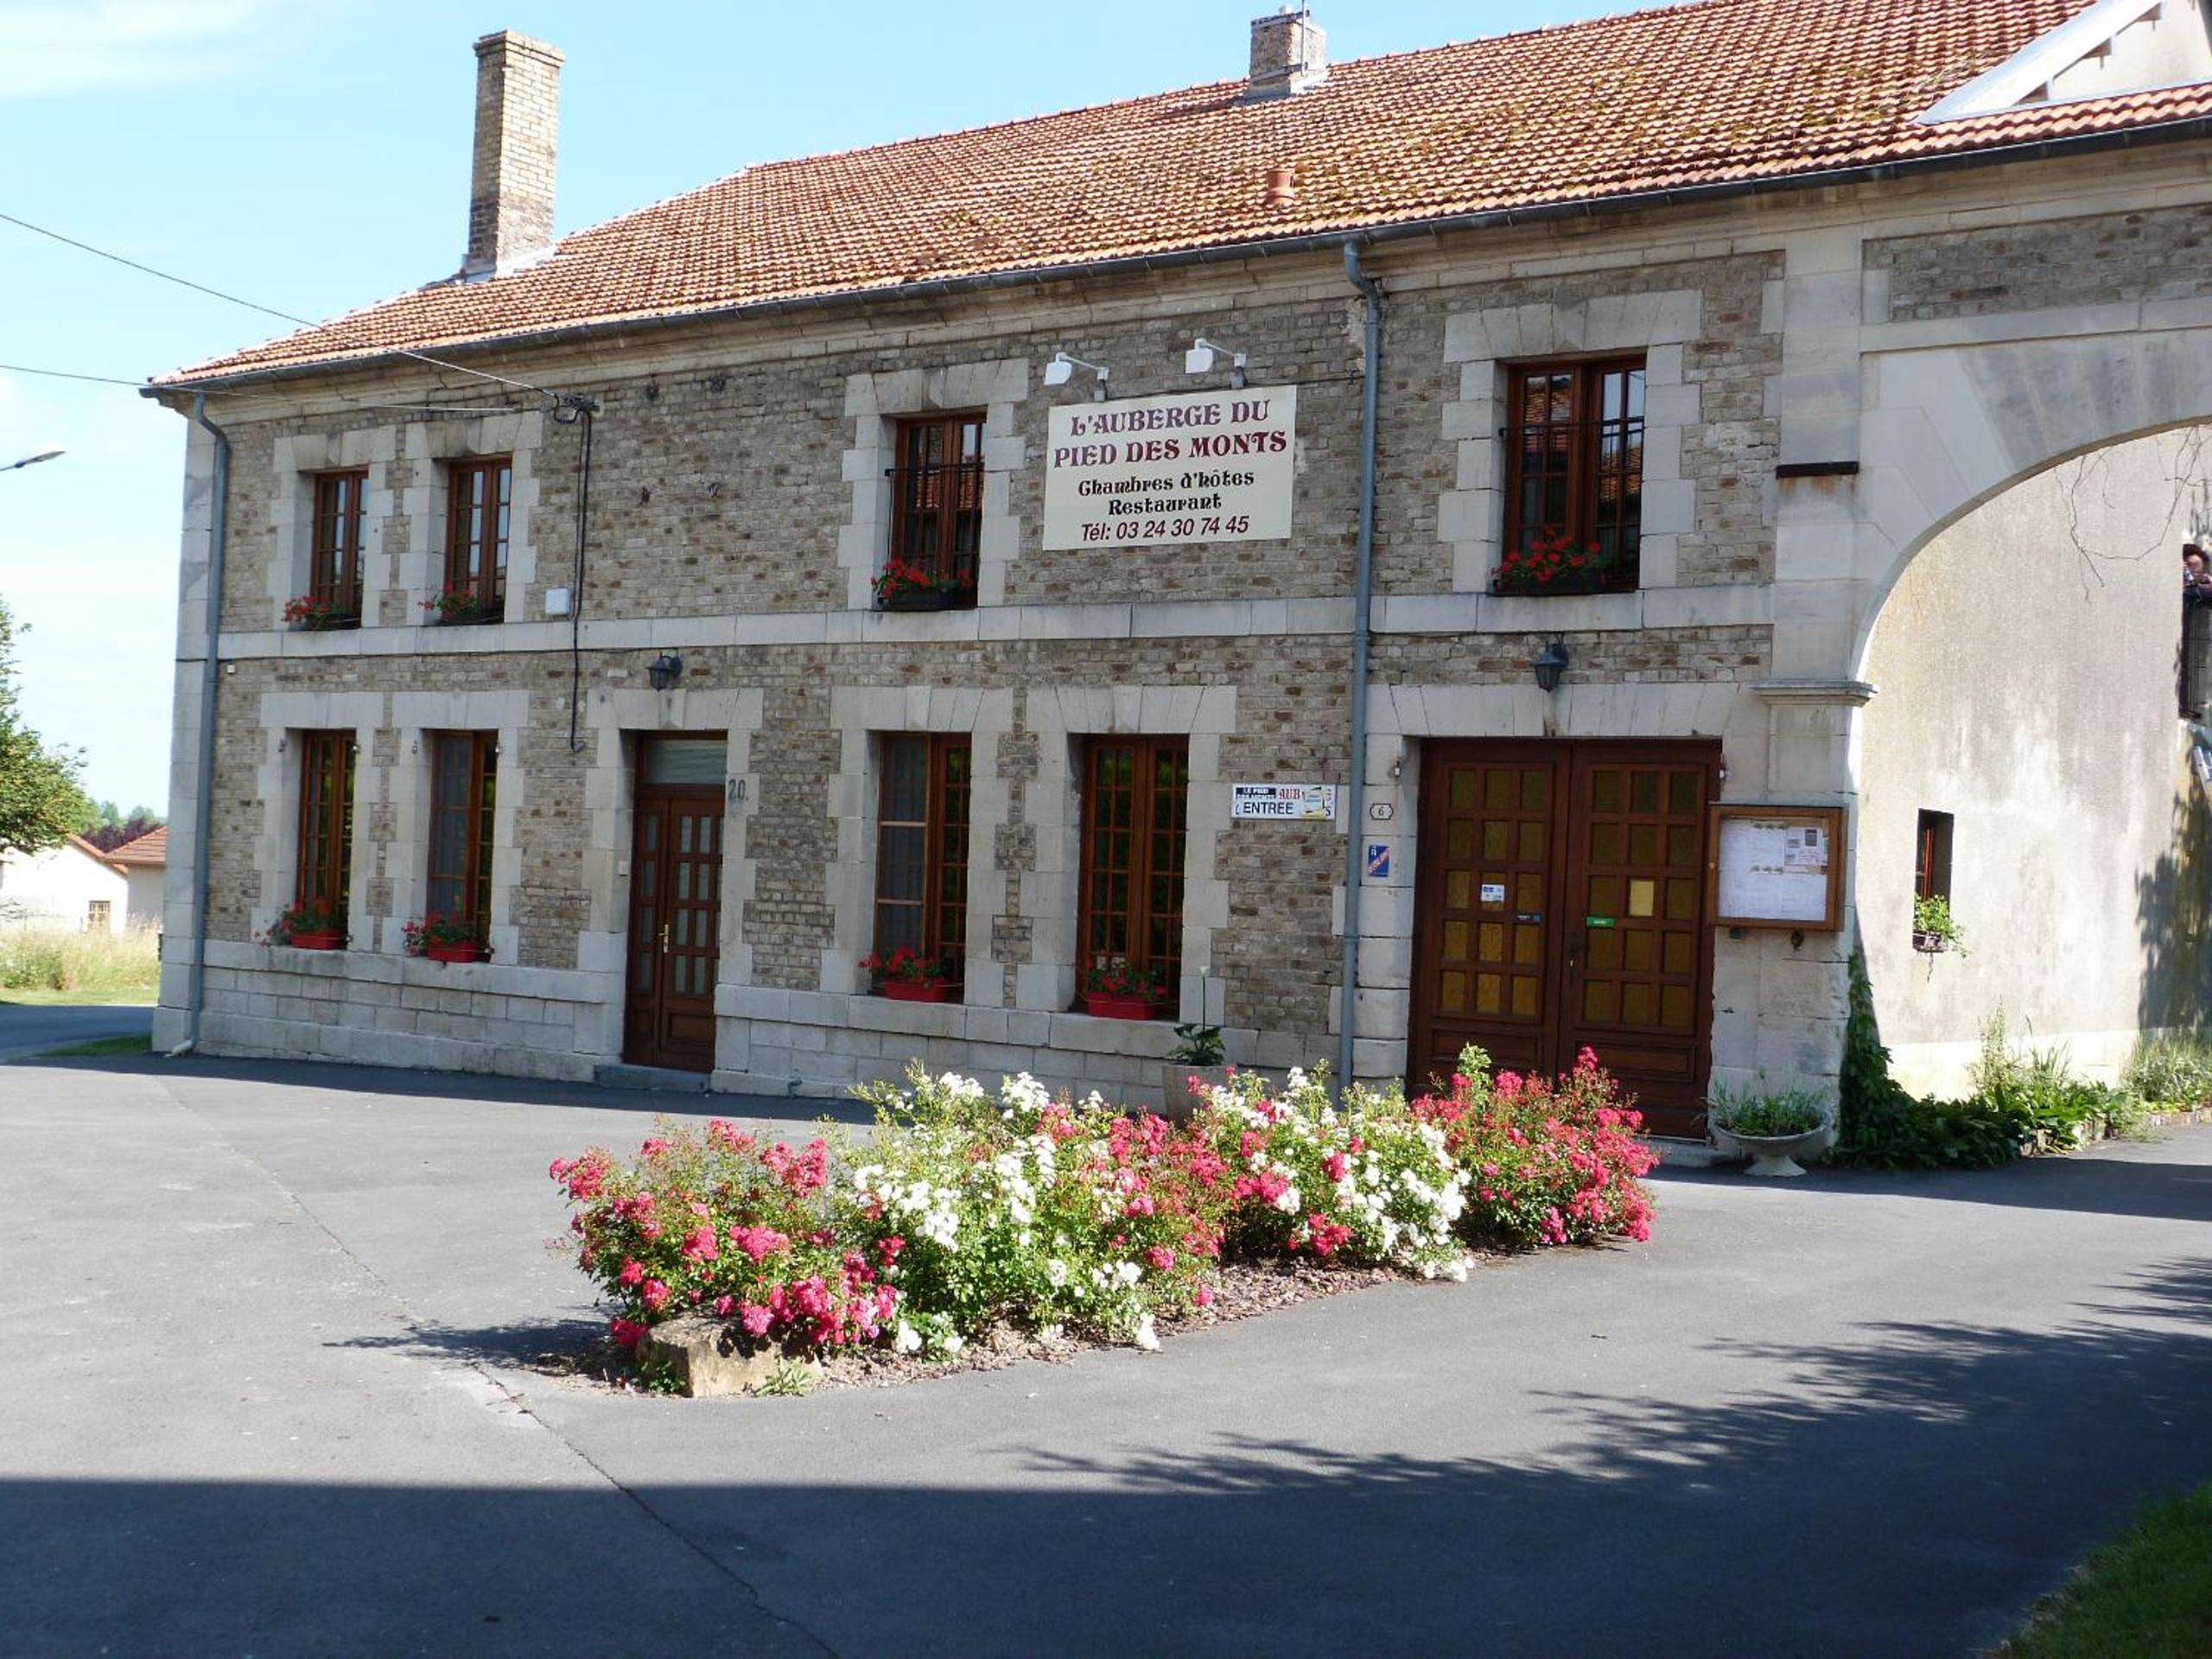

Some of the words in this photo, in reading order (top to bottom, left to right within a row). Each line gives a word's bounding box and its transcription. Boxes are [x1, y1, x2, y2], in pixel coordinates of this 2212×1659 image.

[1070, 404, 1221, 437] L'AUBERGE
[1230, 399, 1270, 423] DU
[1053, 444, 1117, 468] PIED
[1125, 438, 1179, 462] DES
[1188, 430, 1287, 458] MONTS
[1077, 474, 1173, 497] Chambres
[1180, 469, 1255, 490] d'hôtes
[1108, 493, 1223, 516] Restaurant
[1082, 522, 1111, 542] Tél:
[1116, 521, 1139, 540] 03
[1142, 519, 1166, 538] 24
[1170, 518, 1195, 537] 30
[1200, 517, 1221, 535] 74
[1225, 515, 1250, 534] 45
[1243, 802, 1294, 815] ENTREE
